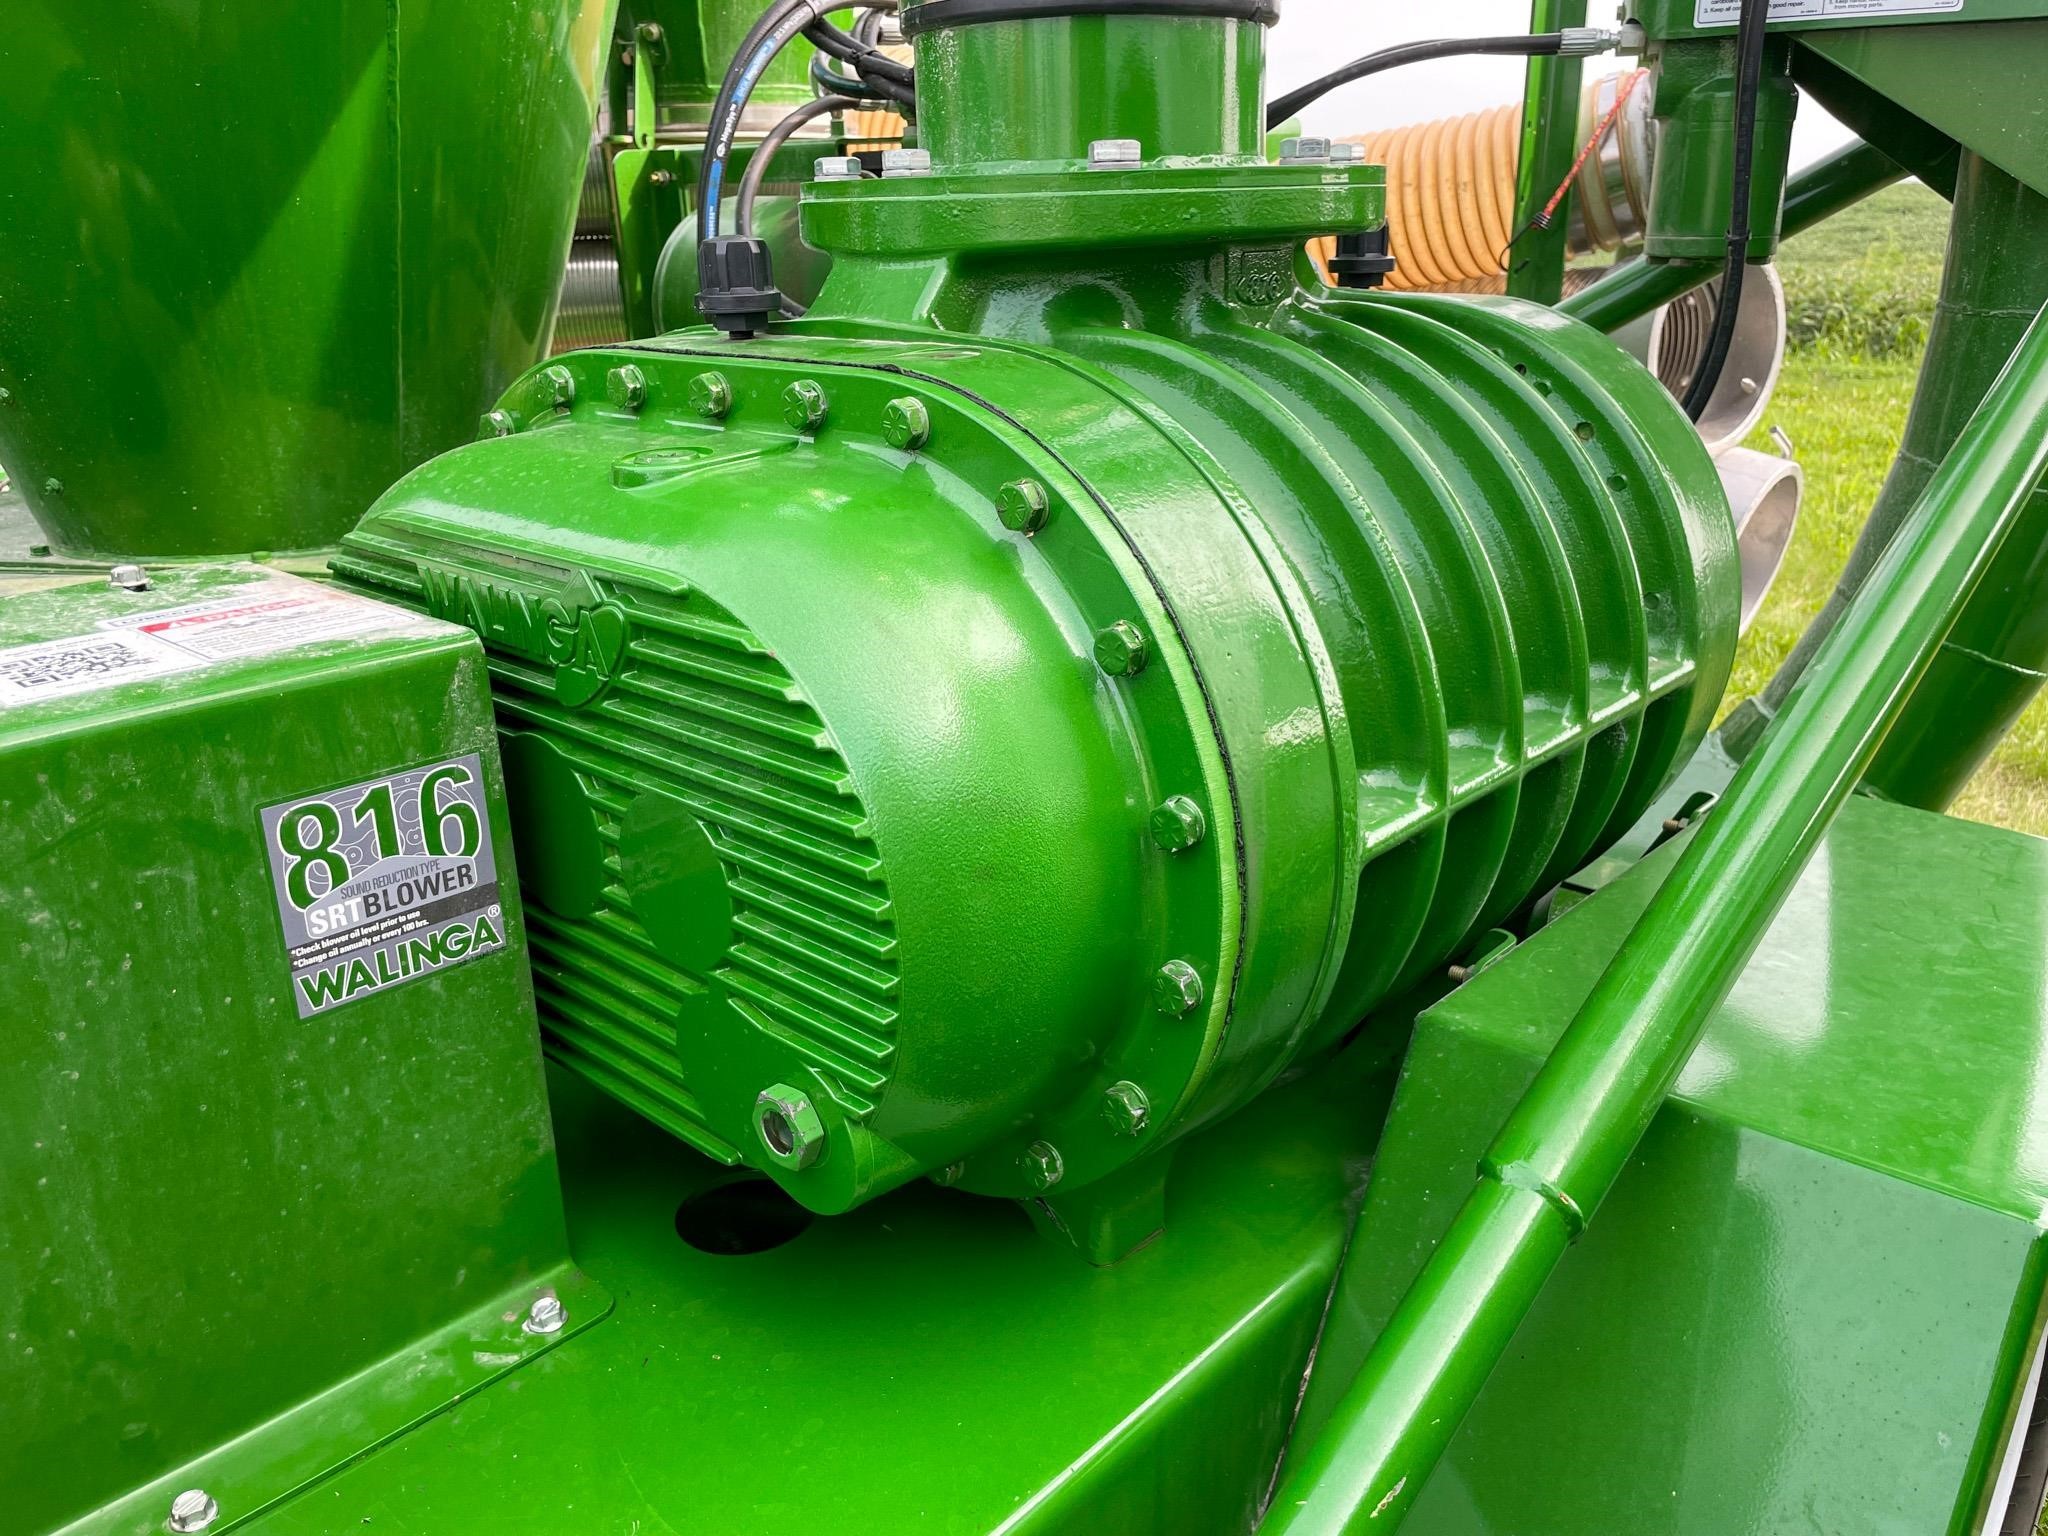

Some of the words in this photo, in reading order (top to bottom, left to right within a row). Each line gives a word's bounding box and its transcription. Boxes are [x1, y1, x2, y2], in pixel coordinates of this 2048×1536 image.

[277, 764, 482, 912] 816
[341, 881, 372, 900] SOUND
[373, 866, 420, 891] REDUCTION
[420, 858, 441, 875] TYPE
[321, 934, 350, 949] blower
[350, 929, 360, 939] oil
[361, 923, 380, 936] level
[380, 917, 398, 932] prior
[399, 914, 406, 922] to
[407, 910, 420, 920] use
[328, 948, 339, 957] oil
[340, 937, 372, 954] annually
[372, 934, 381, 943] or
[382, 927, 402, 940] every
[402, 922, 415, 933] 100
[416, 919, 430, 929] hrs.
